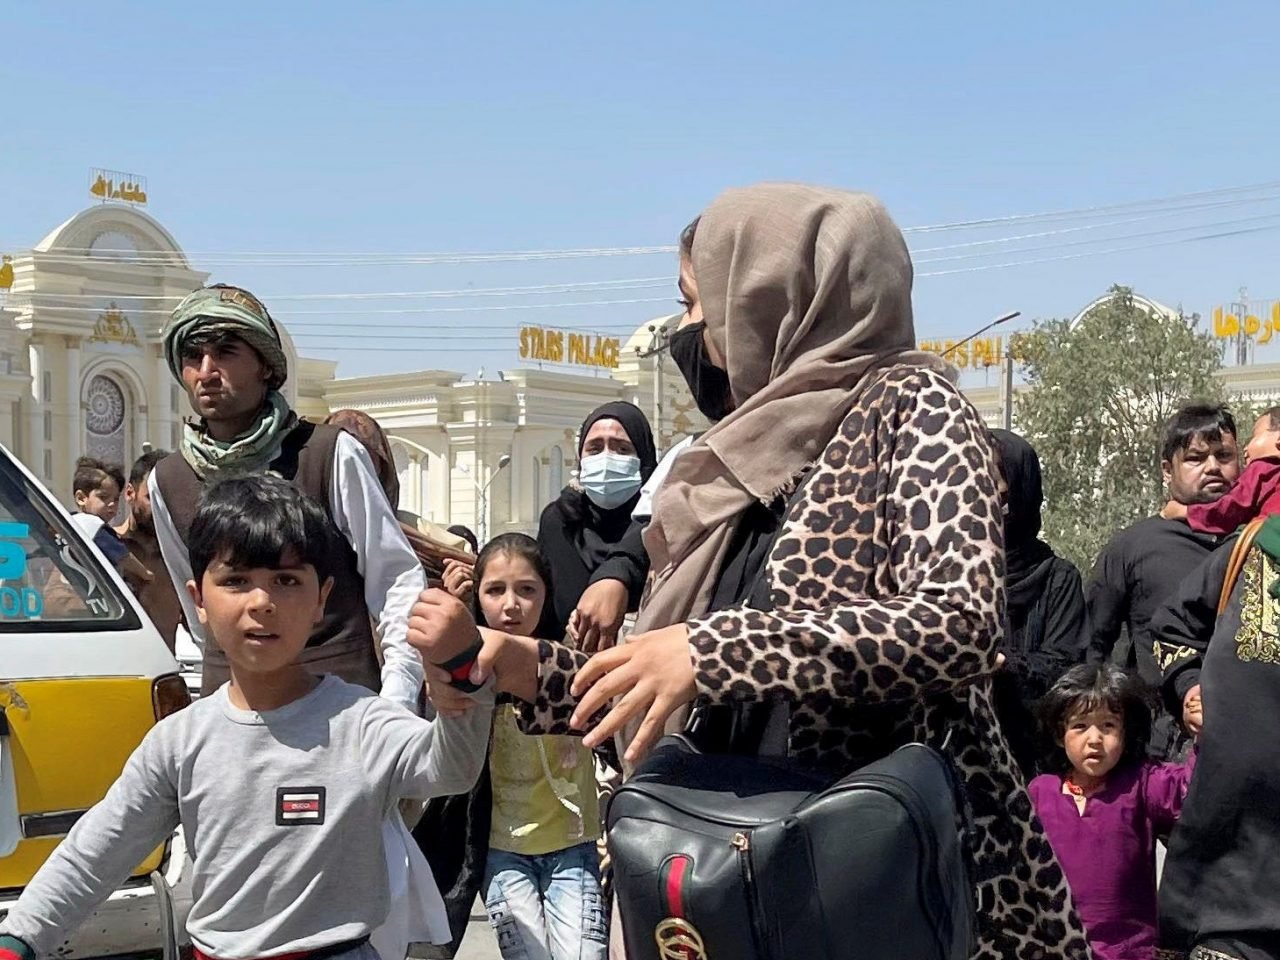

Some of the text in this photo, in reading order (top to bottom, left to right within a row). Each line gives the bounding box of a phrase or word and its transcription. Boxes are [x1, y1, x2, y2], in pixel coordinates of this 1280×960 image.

[519, 327, 620, 369] STARS PALACE
[85, 597, 109, 615] TV
